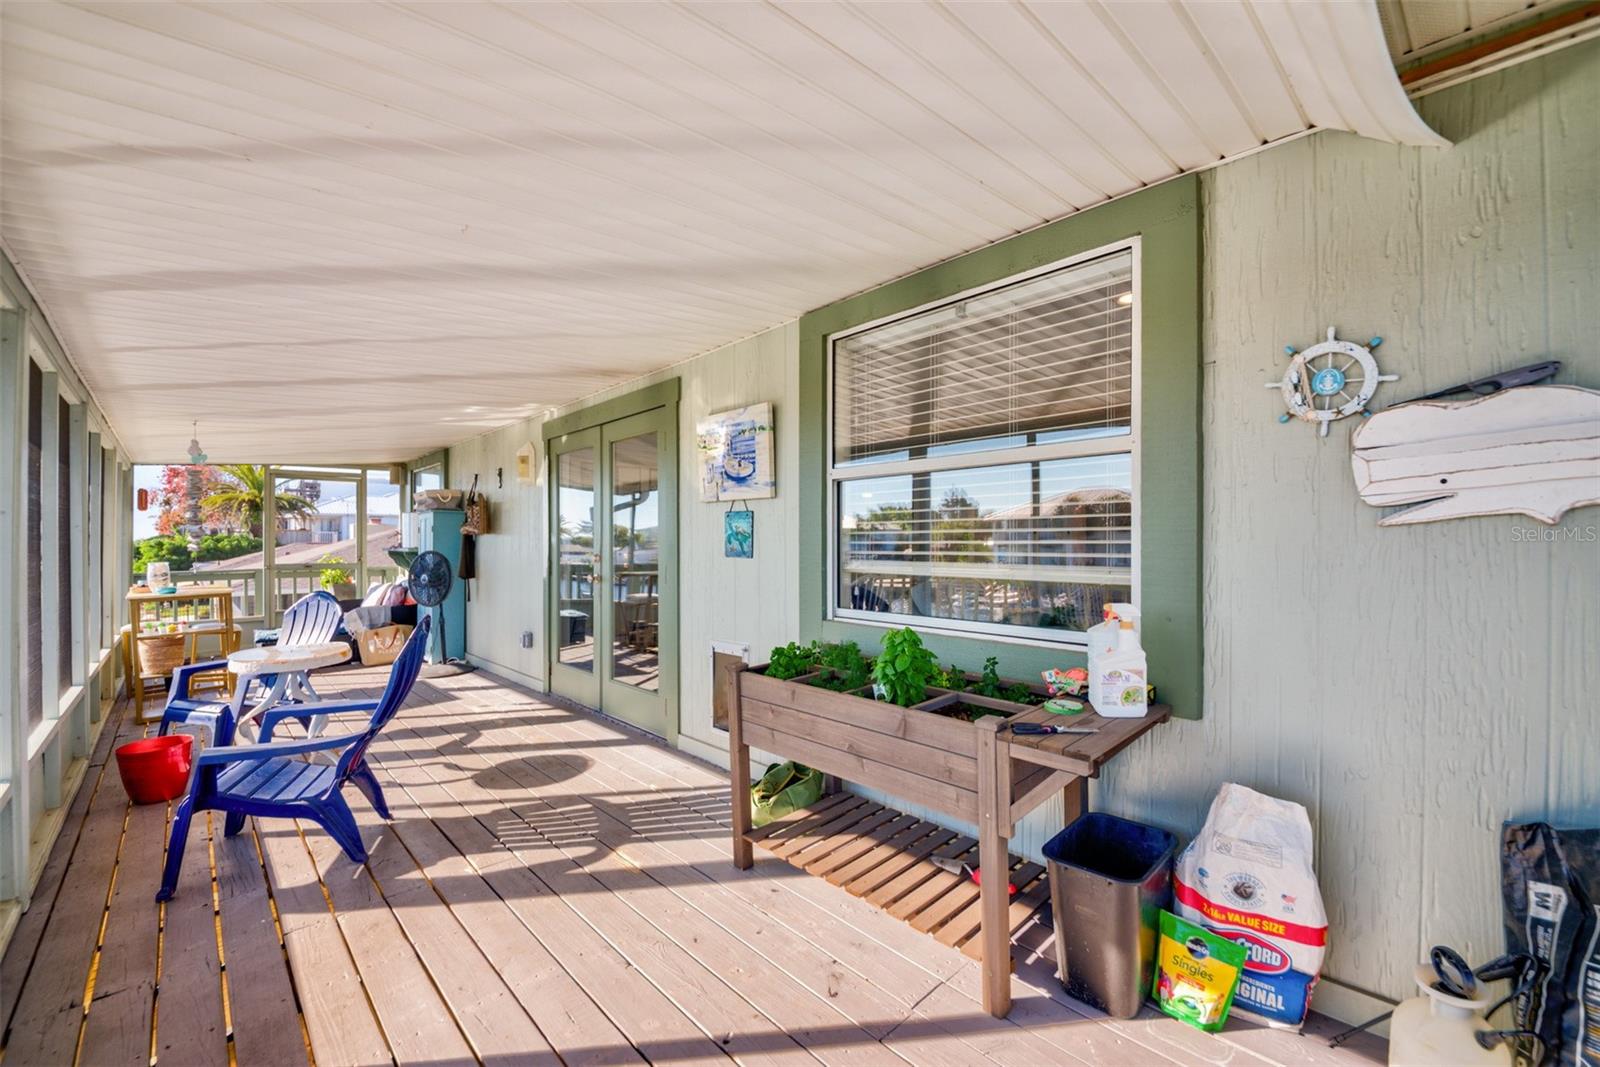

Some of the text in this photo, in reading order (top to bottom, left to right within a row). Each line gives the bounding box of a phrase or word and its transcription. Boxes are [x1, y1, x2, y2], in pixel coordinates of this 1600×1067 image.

[1227, 911, 1261, 929] VALUE
[1261, 920, 1286, 935] SIZE
[1171, 954, 1214, 982] Singles
[1235, 980, 1285, 1011] IGINAL
